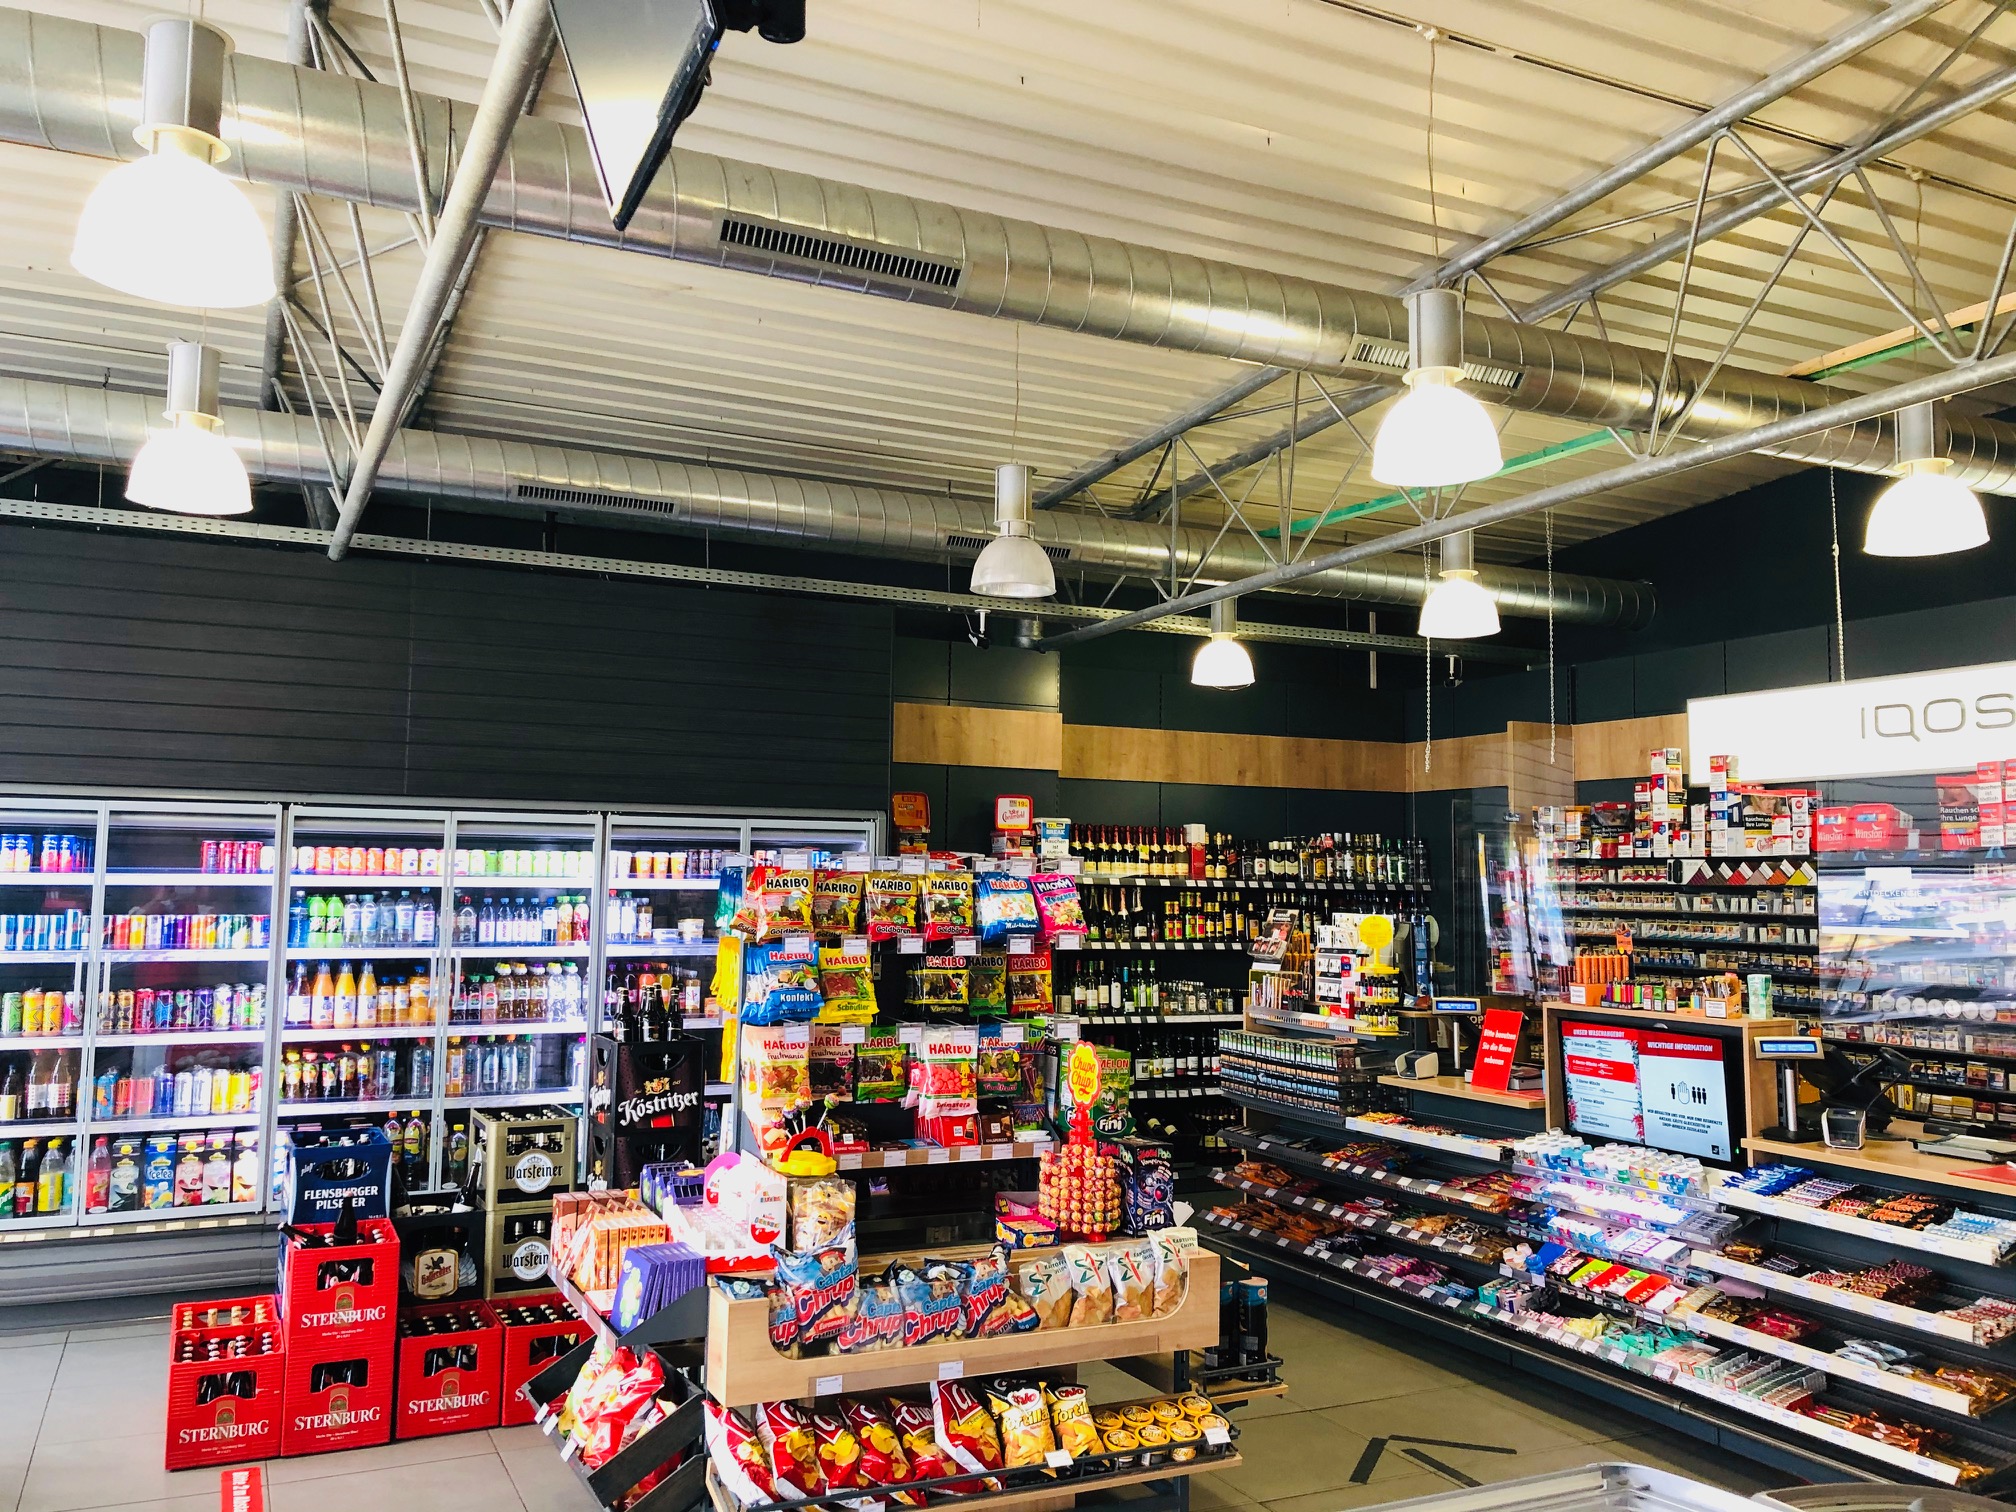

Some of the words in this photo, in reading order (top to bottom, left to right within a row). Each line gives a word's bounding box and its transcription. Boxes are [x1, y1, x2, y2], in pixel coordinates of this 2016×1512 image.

[1861, 693, 2015, 742] IQOS
[1940, 806, 1969, 814] Rauchen
[1955, 814, 1978, 822] Lunge
[1817, 832, 1843, 842] Winston
[1854, 828, 1883, 840] Winston
[766, 877, 809, 890] HARIBO
[815, 881, 857, 894] HARIBO
[872, 878, 912, 892] HARIBO
[931, 879, 969, 892] HARIBO
[990, 876, 1027, 890] HARIBO
[876, 925, 912, 935] Goldbären
[936, 926, 970, 935] Goldbären
[769, 952, 814, 962] HARIBO
[825, 955, 867, 966] HARIBO
[926, 955, 967, 968] HARIBO
[969, 956, 1004, 967] HARIBO
[1012, 956, 1047, 969] HARIBO
[780, 992, 814, 1003] Konfekt
[1483, 1029, 1495, 1038] Bitte
[1495, 1030, 1517, 1040] benutzen
[1588, 1029, 1625, 1038] WASCHANGEBOT
[763, 1039, 806, 1050] HARIBO
[929, 1043, 972, 1055] HARIBO
[1482, 1041, 1490, 1050] Sie
[1490, 1043, 1498, 1051] die
[1498, 1044, 1512, 1053] Kasse
[1647, 1041, 1674, 1050] WICHTIGE
[1674, 1042, 1713, 1052] INFORMATION
[767, 1051, 805, 1061] Fruitmania
[811, 1048, 852, 1058] Fruitmania
[1073, 1055, 1096, 1074] Chupa
[1071, 1071, 1095, 1089] Chups
[617, 1091, 700, 1127] Köstritzer
[1098, 1114, 1123, 1132] Fini
[505, 1164, 563, 1180] Warsteiner
[304, 1185, 378, 1200] FLENSBURGER
[316, 1197, 366, 1210] PILSEER
[1143, 1211, 1165, 1226] Fini
[795, 1274, 855, 1326] Chrup
[301, 1306, 386, 1329] STERNBURG
[838, 1313, 905, 1349] Chrup
[904, 1307, 962, 1346] Chrup
[408, 1390, 490, 1415] STERNBURG
[294, 1406, 381, 1431] STERNBURG
[1001, 1407, 1050, 1434] Tortilla
[179, 1419, 270, 1444] STERNBURG
